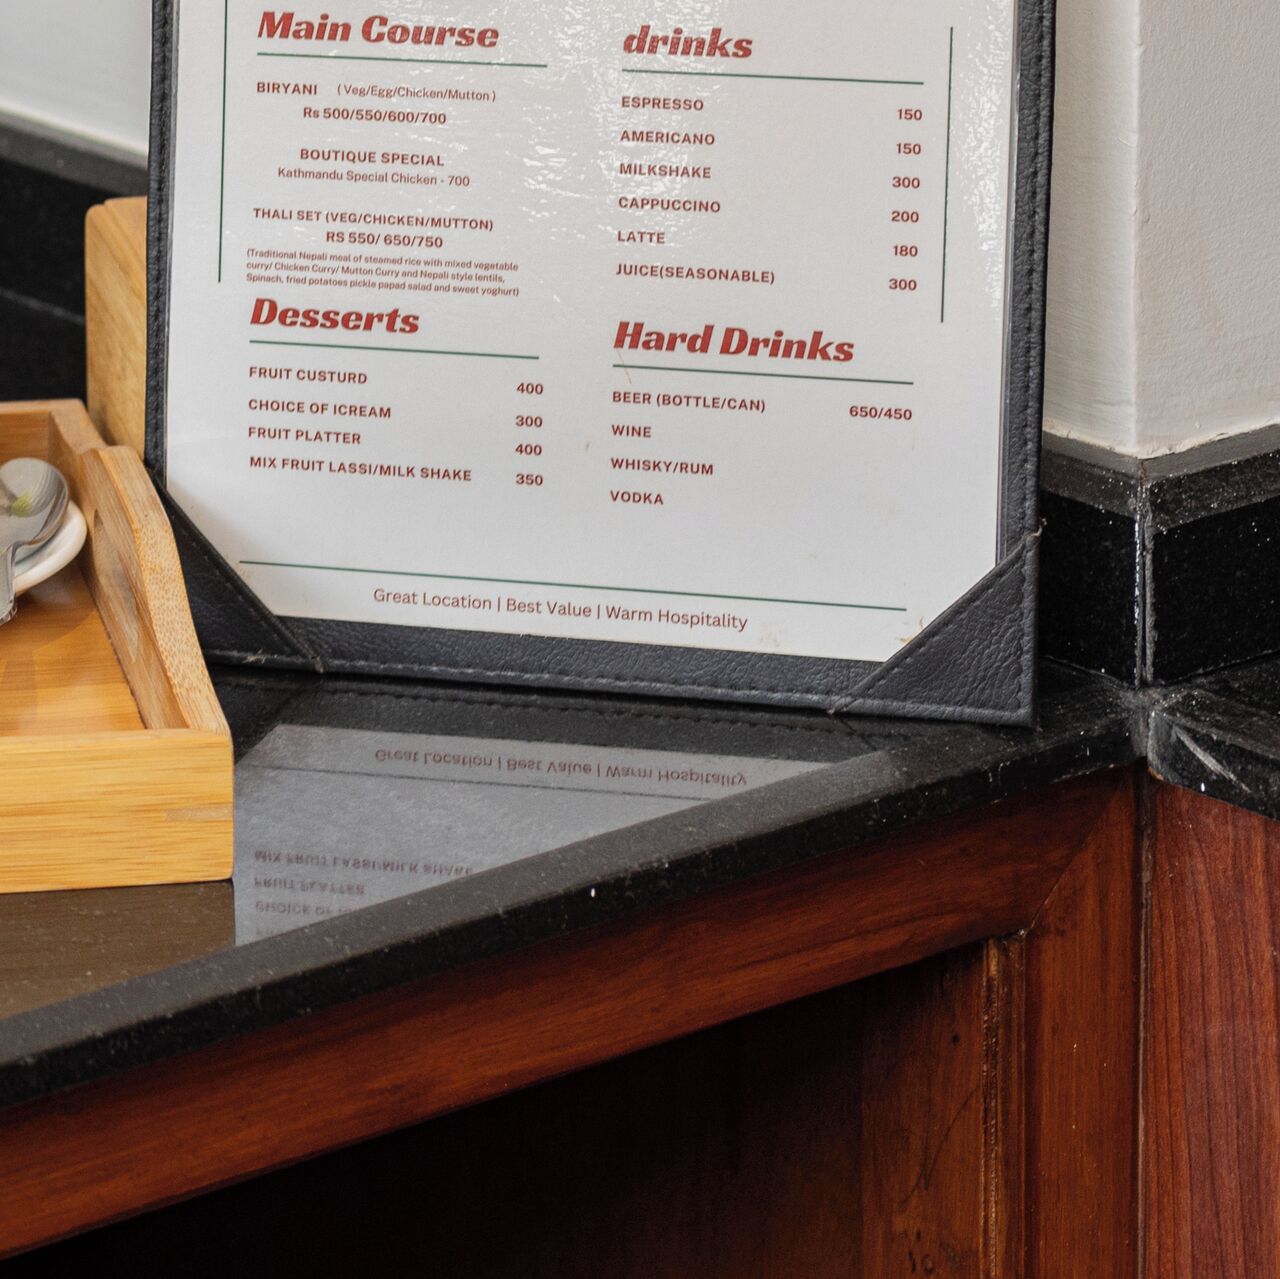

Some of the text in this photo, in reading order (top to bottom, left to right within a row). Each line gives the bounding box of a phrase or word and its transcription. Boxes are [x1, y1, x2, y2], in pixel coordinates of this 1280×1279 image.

[257, 11, 499, 48] Main Course
[623, 25, 753, 58] drinks
[257, 82, 318, 95] BIRYANI
[304, 107, 446, 124] Rs 500/550/600/700
[622, 96, 922, 121] ESPRESSO 150
[620, 130, 921, 155] AMERICANO 150
[300, 149, 444, 166] BOUTIQUE SPECIAL
[278, 168, 470, 186] Kathmandu Special Chicken 700
[619, 164, 920, 189] MILKSHAKE 300
[254, 208, 493, 231] THALI SET (VEG/CHICKEN/MUTTON)
[619, 197, 919, 223] CAPPUCCINO 200
[326, 232, 344, 243] RS
[384, 234, 443, 248] 650/750
[617, 231, 918, 257] LATTE 180
[275, 263, 309, 273] Chicken
[342, 266, 373, 276] Mutton
[376, 268, 399, 278] Curry
[402, 269, 418, 278] and
[421, 270, 449, 280] Nepali
[451, 272, 472, 281] style
[300, 251, 327, 263] Nepali
[330, 253, 351, 262] meal
[353, 254, 362, 262] of
[365, 255, 402, 265] steamed
[405, 257, 422, 266] rice
[424, 258, 442, 267] with
[445, 259, 471, 268] mixed
[474, 261, 518, 271] vegetable
[287, 275, 306, 284] fried
[309, 277, 347, 288] potatoes
[350, 278, 376, 289] pickle
[378, 280, 405, 291] papad
[408, 282, 432, 291] salad
[434, 284, 450, 292] and
[453, 285, 479, 294] sweet
[616, 264, 917, 291] JUICE(SEASONABLE) 300
[251, 298, 419, 334] Desserts
[613, 321, 854, 362] Hard Drinks
[250, 366, 543, 394] FRUIT CUSTURD 400
[249, 399, 542, 428] CHOICE OF ICREAM 300
[613, 391, 912, 420] BEER (BOTTLE/CAN) 650/450
[248, 427, 542, 455] FRUIT PLATTER 400
[612, 425, 651, 438] WINE
[250, 457, 543, 486] MIX FRUIT LASSI/MILK SHAKE 350
[611, 458, 714, 475] WHISKY/RUM
[610, 490, 664, 505] VODKA
[373, 588, 748, 631] Great Location Best Value Warm Hospitality
